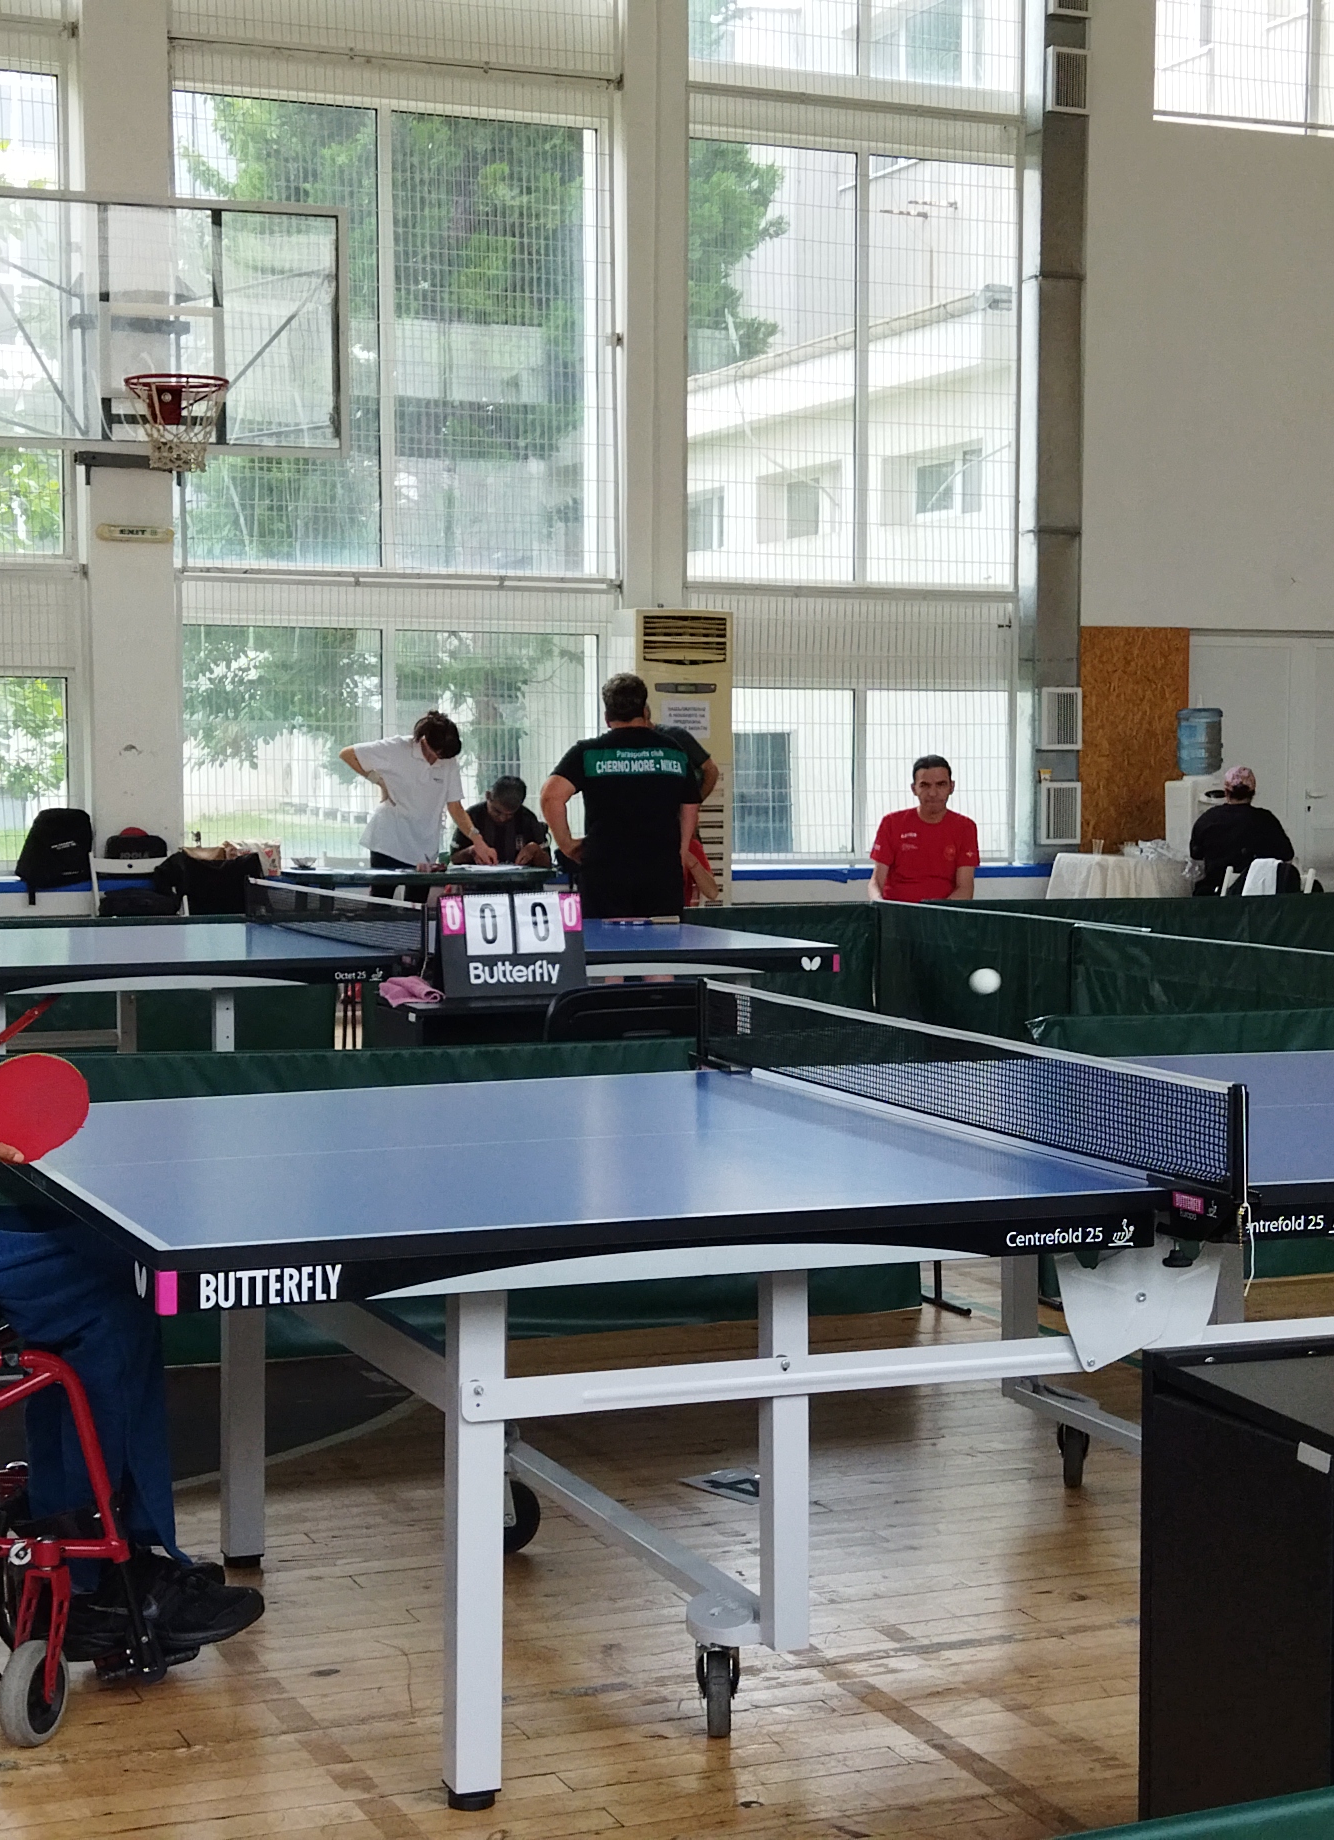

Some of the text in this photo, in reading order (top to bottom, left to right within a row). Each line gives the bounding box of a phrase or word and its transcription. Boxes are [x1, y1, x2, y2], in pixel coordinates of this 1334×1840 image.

[596, 759, 682, 774] CHERNO MORE NIKEA
[445, 897, 577, 945] 0 0 0 0
[334, 970, 367, 980] Octet 25
[468, 959, 561, 985] Butterfly
[1307, 1214, 1325, 1230] 25
[1006, 1227, 1103, 1248] Centrefold 25
[199, 1263, 342, 1310] BUTTERFLY
